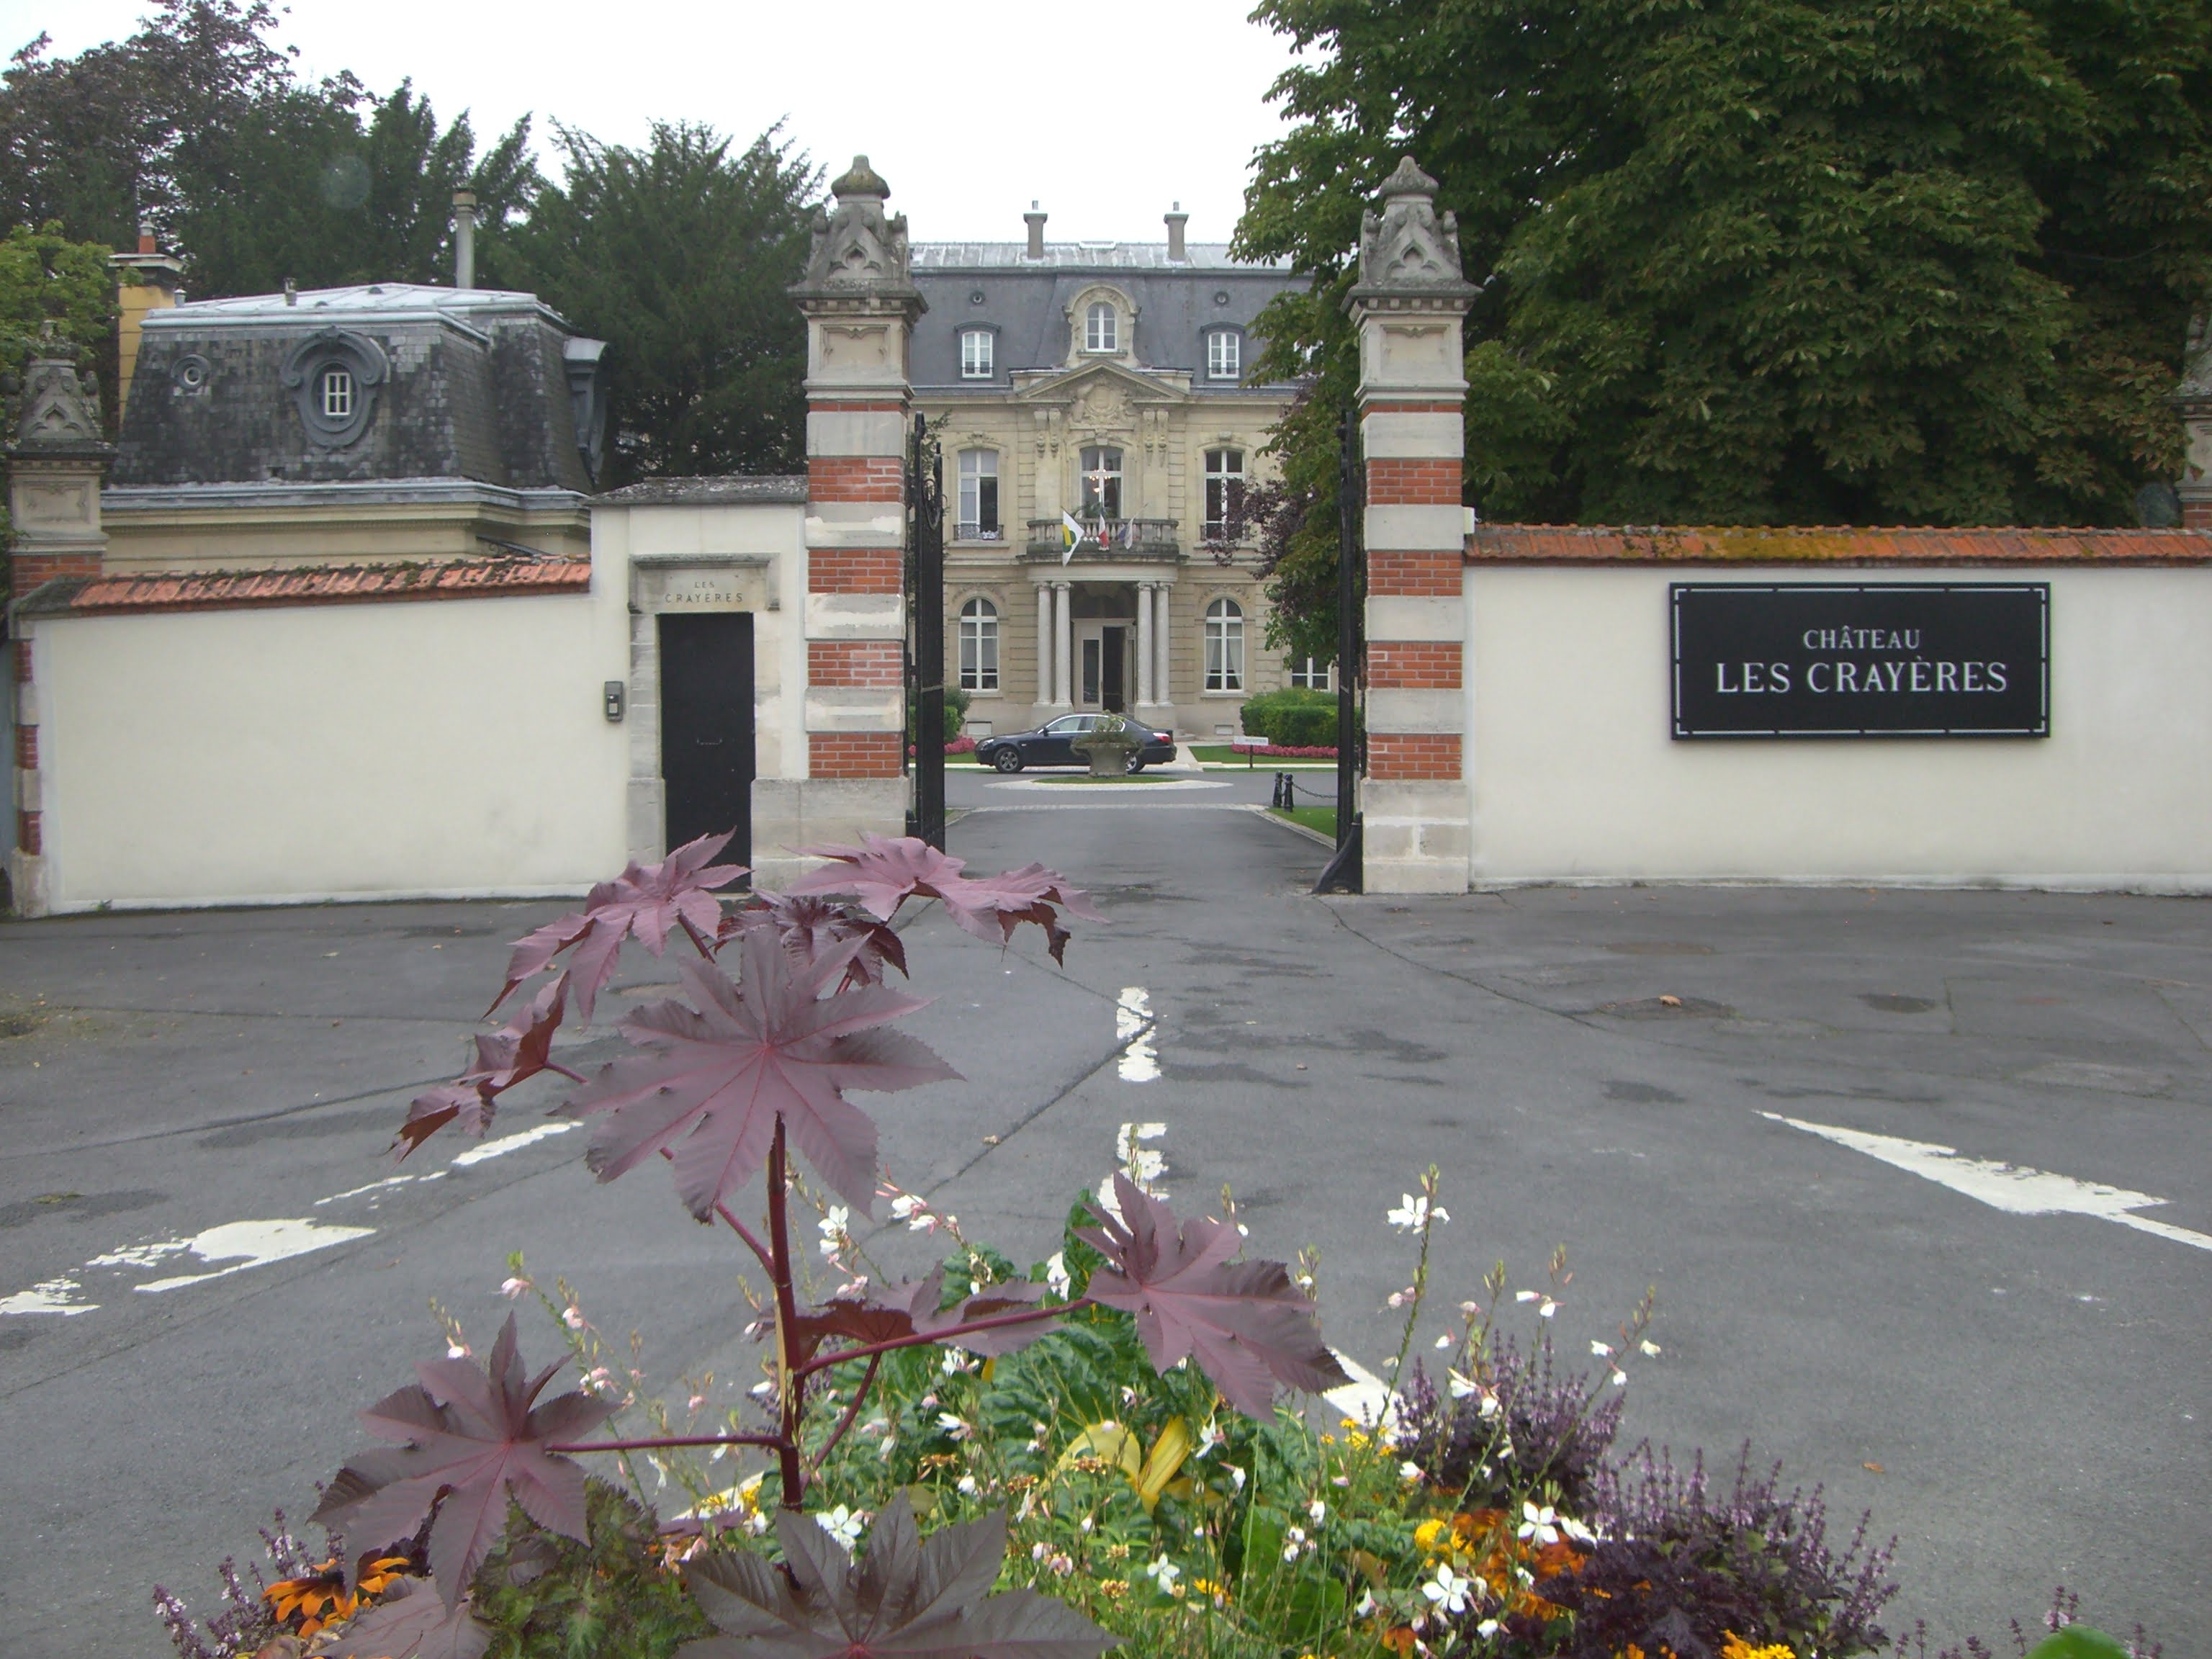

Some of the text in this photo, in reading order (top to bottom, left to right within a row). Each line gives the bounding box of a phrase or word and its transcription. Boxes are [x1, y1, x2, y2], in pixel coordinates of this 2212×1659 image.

[1803, 625, 1920, 649] CHÂTEAU
[1717, 655, 2008, 693] LES CRAYÈRES
